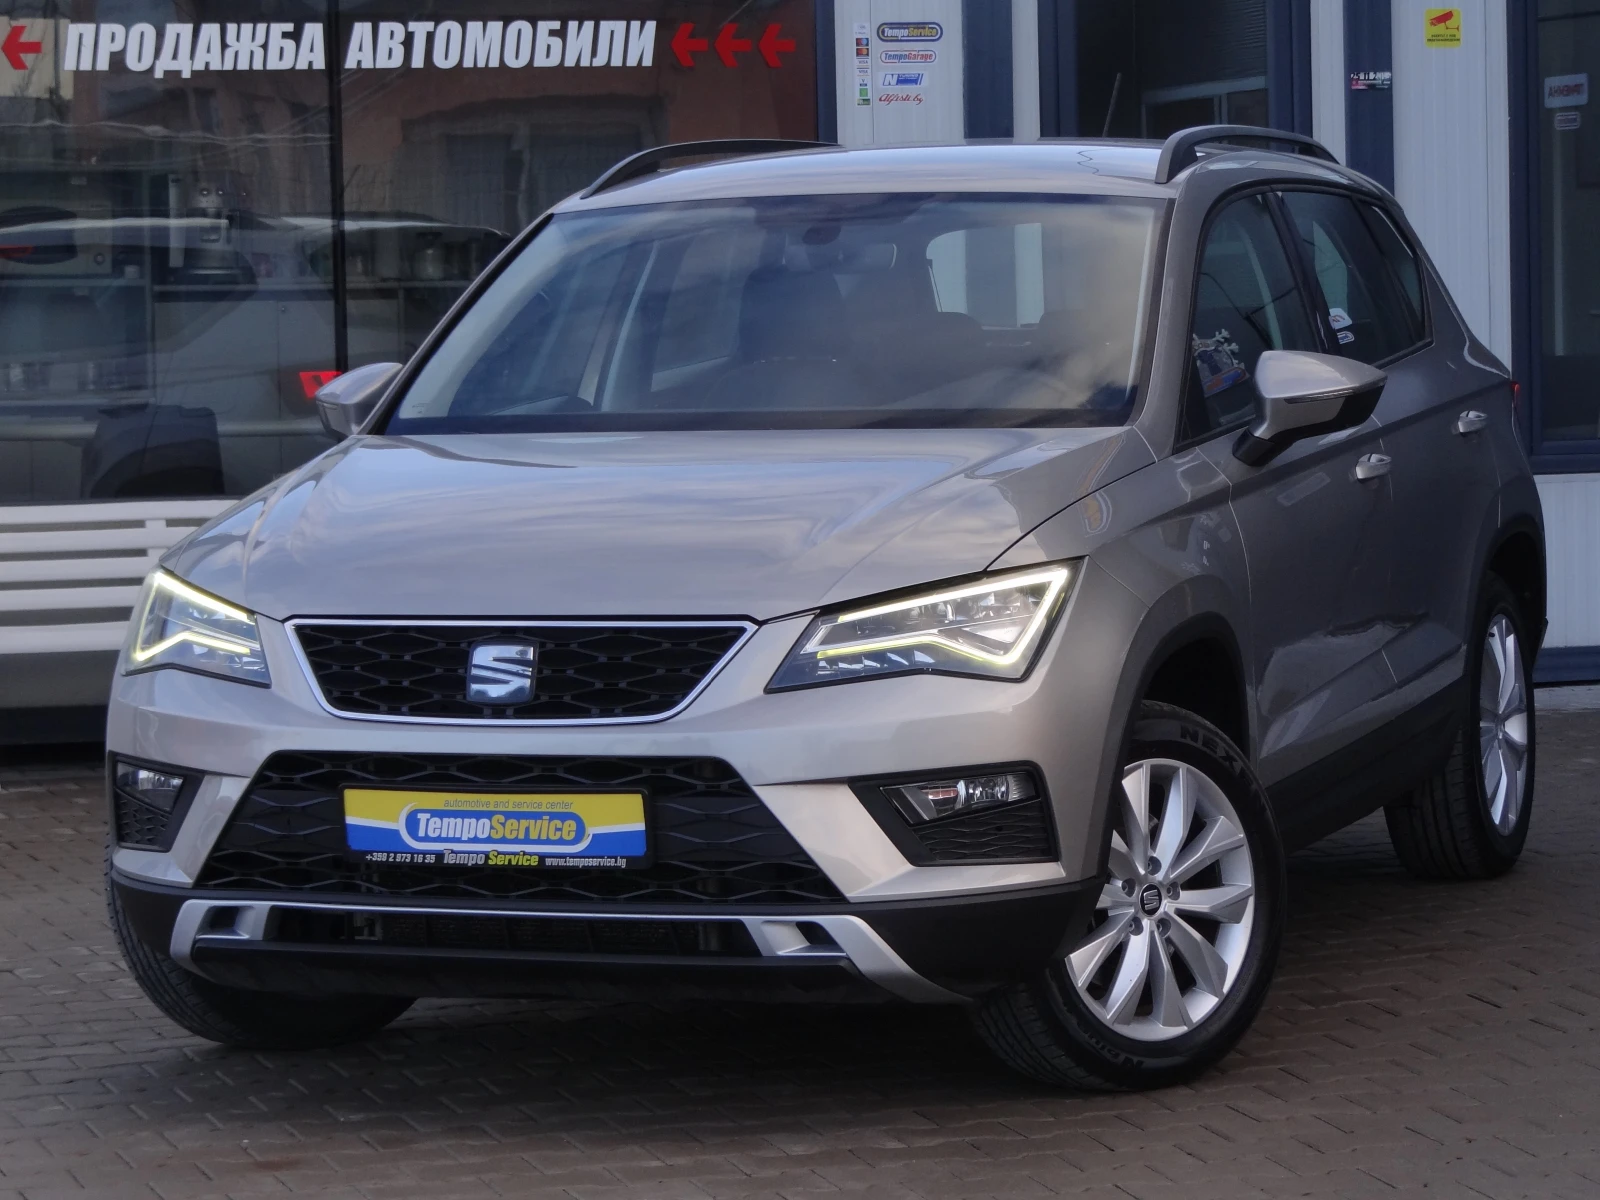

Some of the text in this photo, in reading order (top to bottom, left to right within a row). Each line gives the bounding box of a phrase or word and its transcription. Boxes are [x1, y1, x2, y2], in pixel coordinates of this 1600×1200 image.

[884, 26, 937, 39] TempoService
[64, 20, 657, 79] ПРОДАЖБА АВТОМОБИЛИ
[884, 52, 933, 62] TempoGarage
[444, 799, 573, 809] automotive and service center
[417, 813, 577, 840] TempoService
[366, 849, 626, 868] +359 2 973 16 35 Tempo Service www.temposervice.bg
